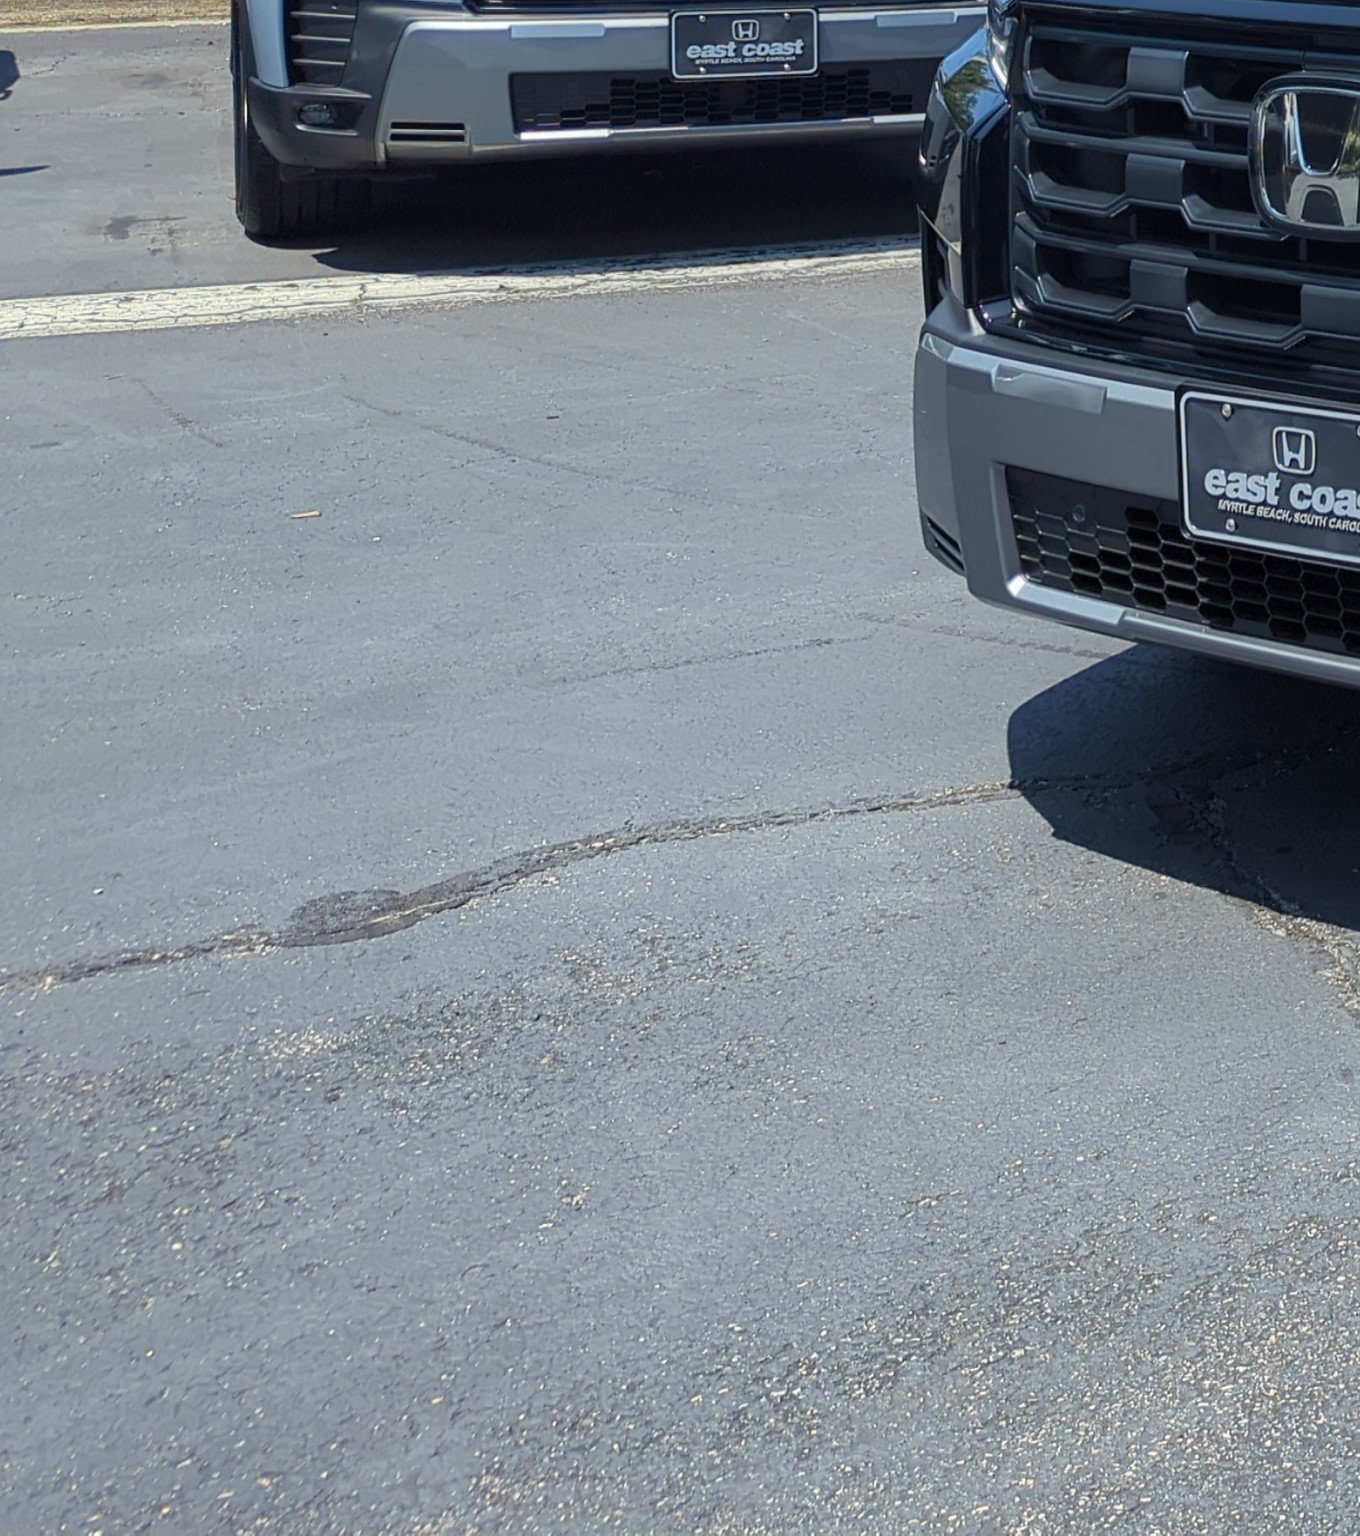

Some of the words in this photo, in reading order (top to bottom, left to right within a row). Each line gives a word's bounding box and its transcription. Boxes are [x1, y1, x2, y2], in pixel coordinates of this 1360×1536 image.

[686, 41, 736, 59] east
[742, 38, 804, 56] coast
[1204, 468, 1280, 505] east
[1217, 498, 1256, 515] MYRTLE
[1256, 505, 1293, 523] BEACH,
[1293, 512, 1327, 528] SOUTH
